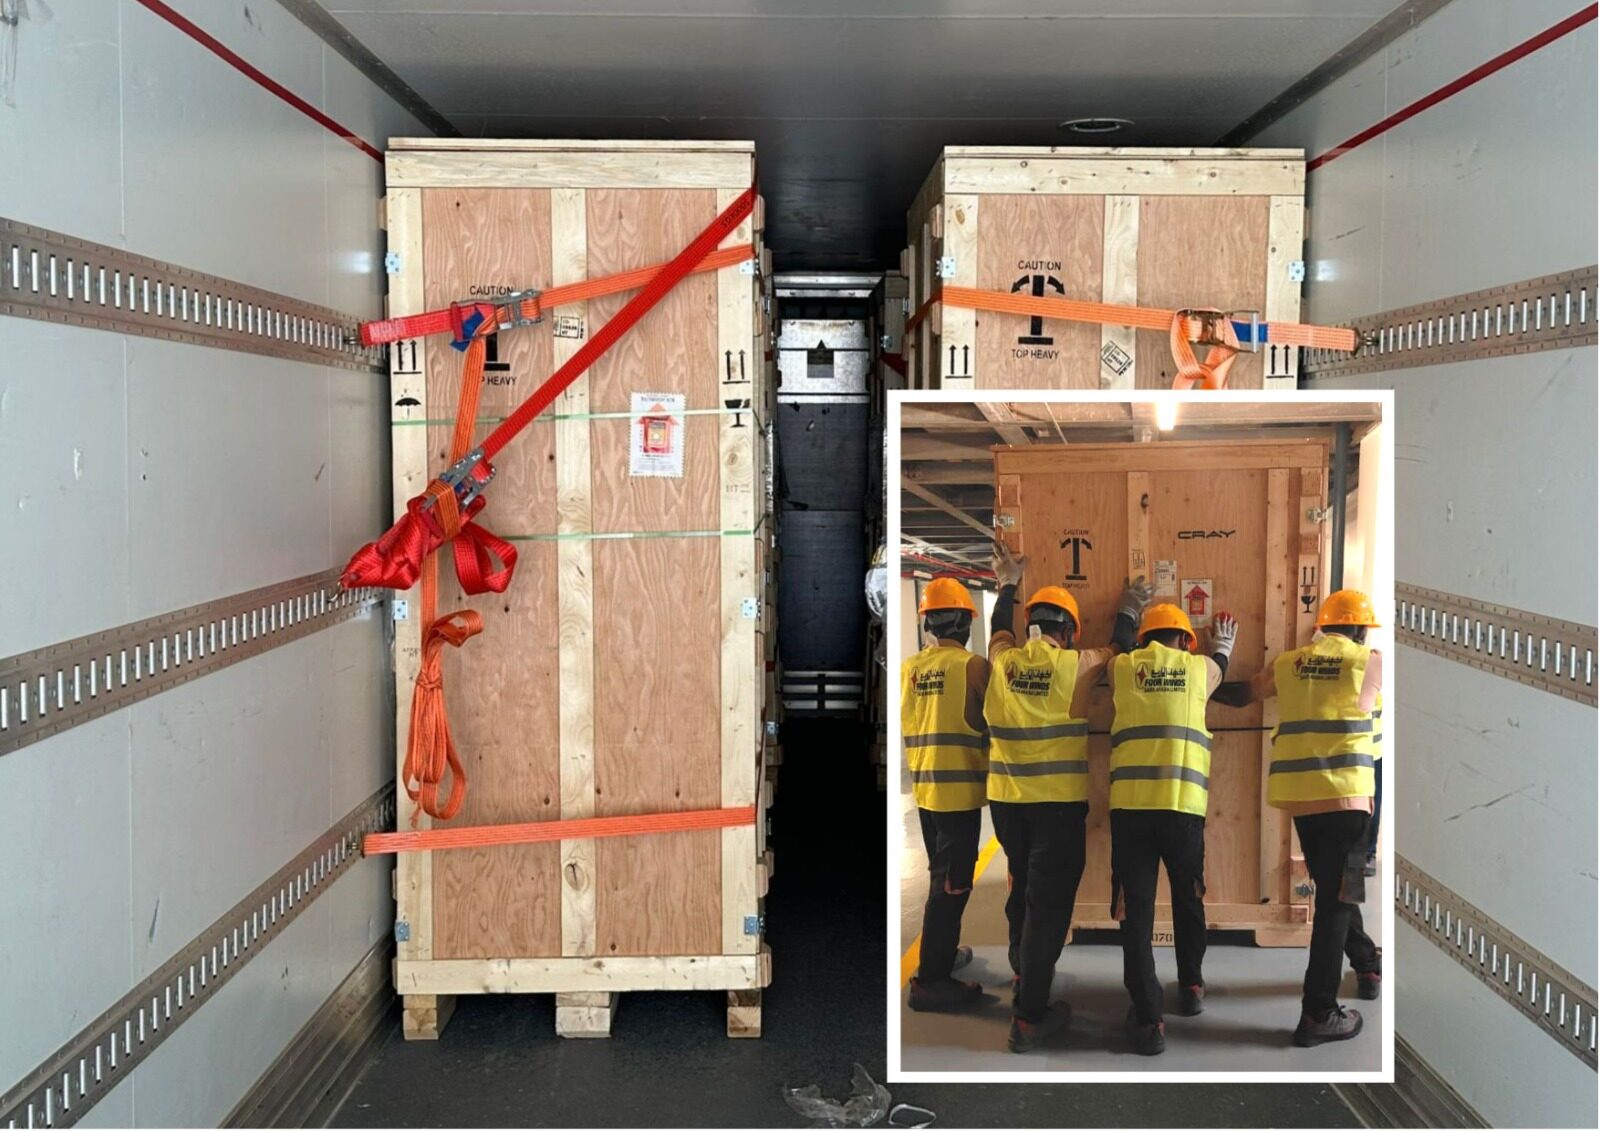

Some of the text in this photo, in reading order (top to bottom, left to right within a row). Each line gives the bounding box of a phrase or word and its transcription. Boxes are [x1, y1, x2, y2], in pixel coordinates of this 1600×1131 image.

[1018, 260, 1061, 270] CAUTION
[469, 285, 514, 296] CAUTION
[1012, 349, 1060, 360] TOP HEAVY
[487, 376, 517, 386] HEAVY
[1177, 529, 1236, 540] CRAY
[1012, 680, 1029, 689] FOUR
[1145, 679, 1186, 687] FOUR WINDS
